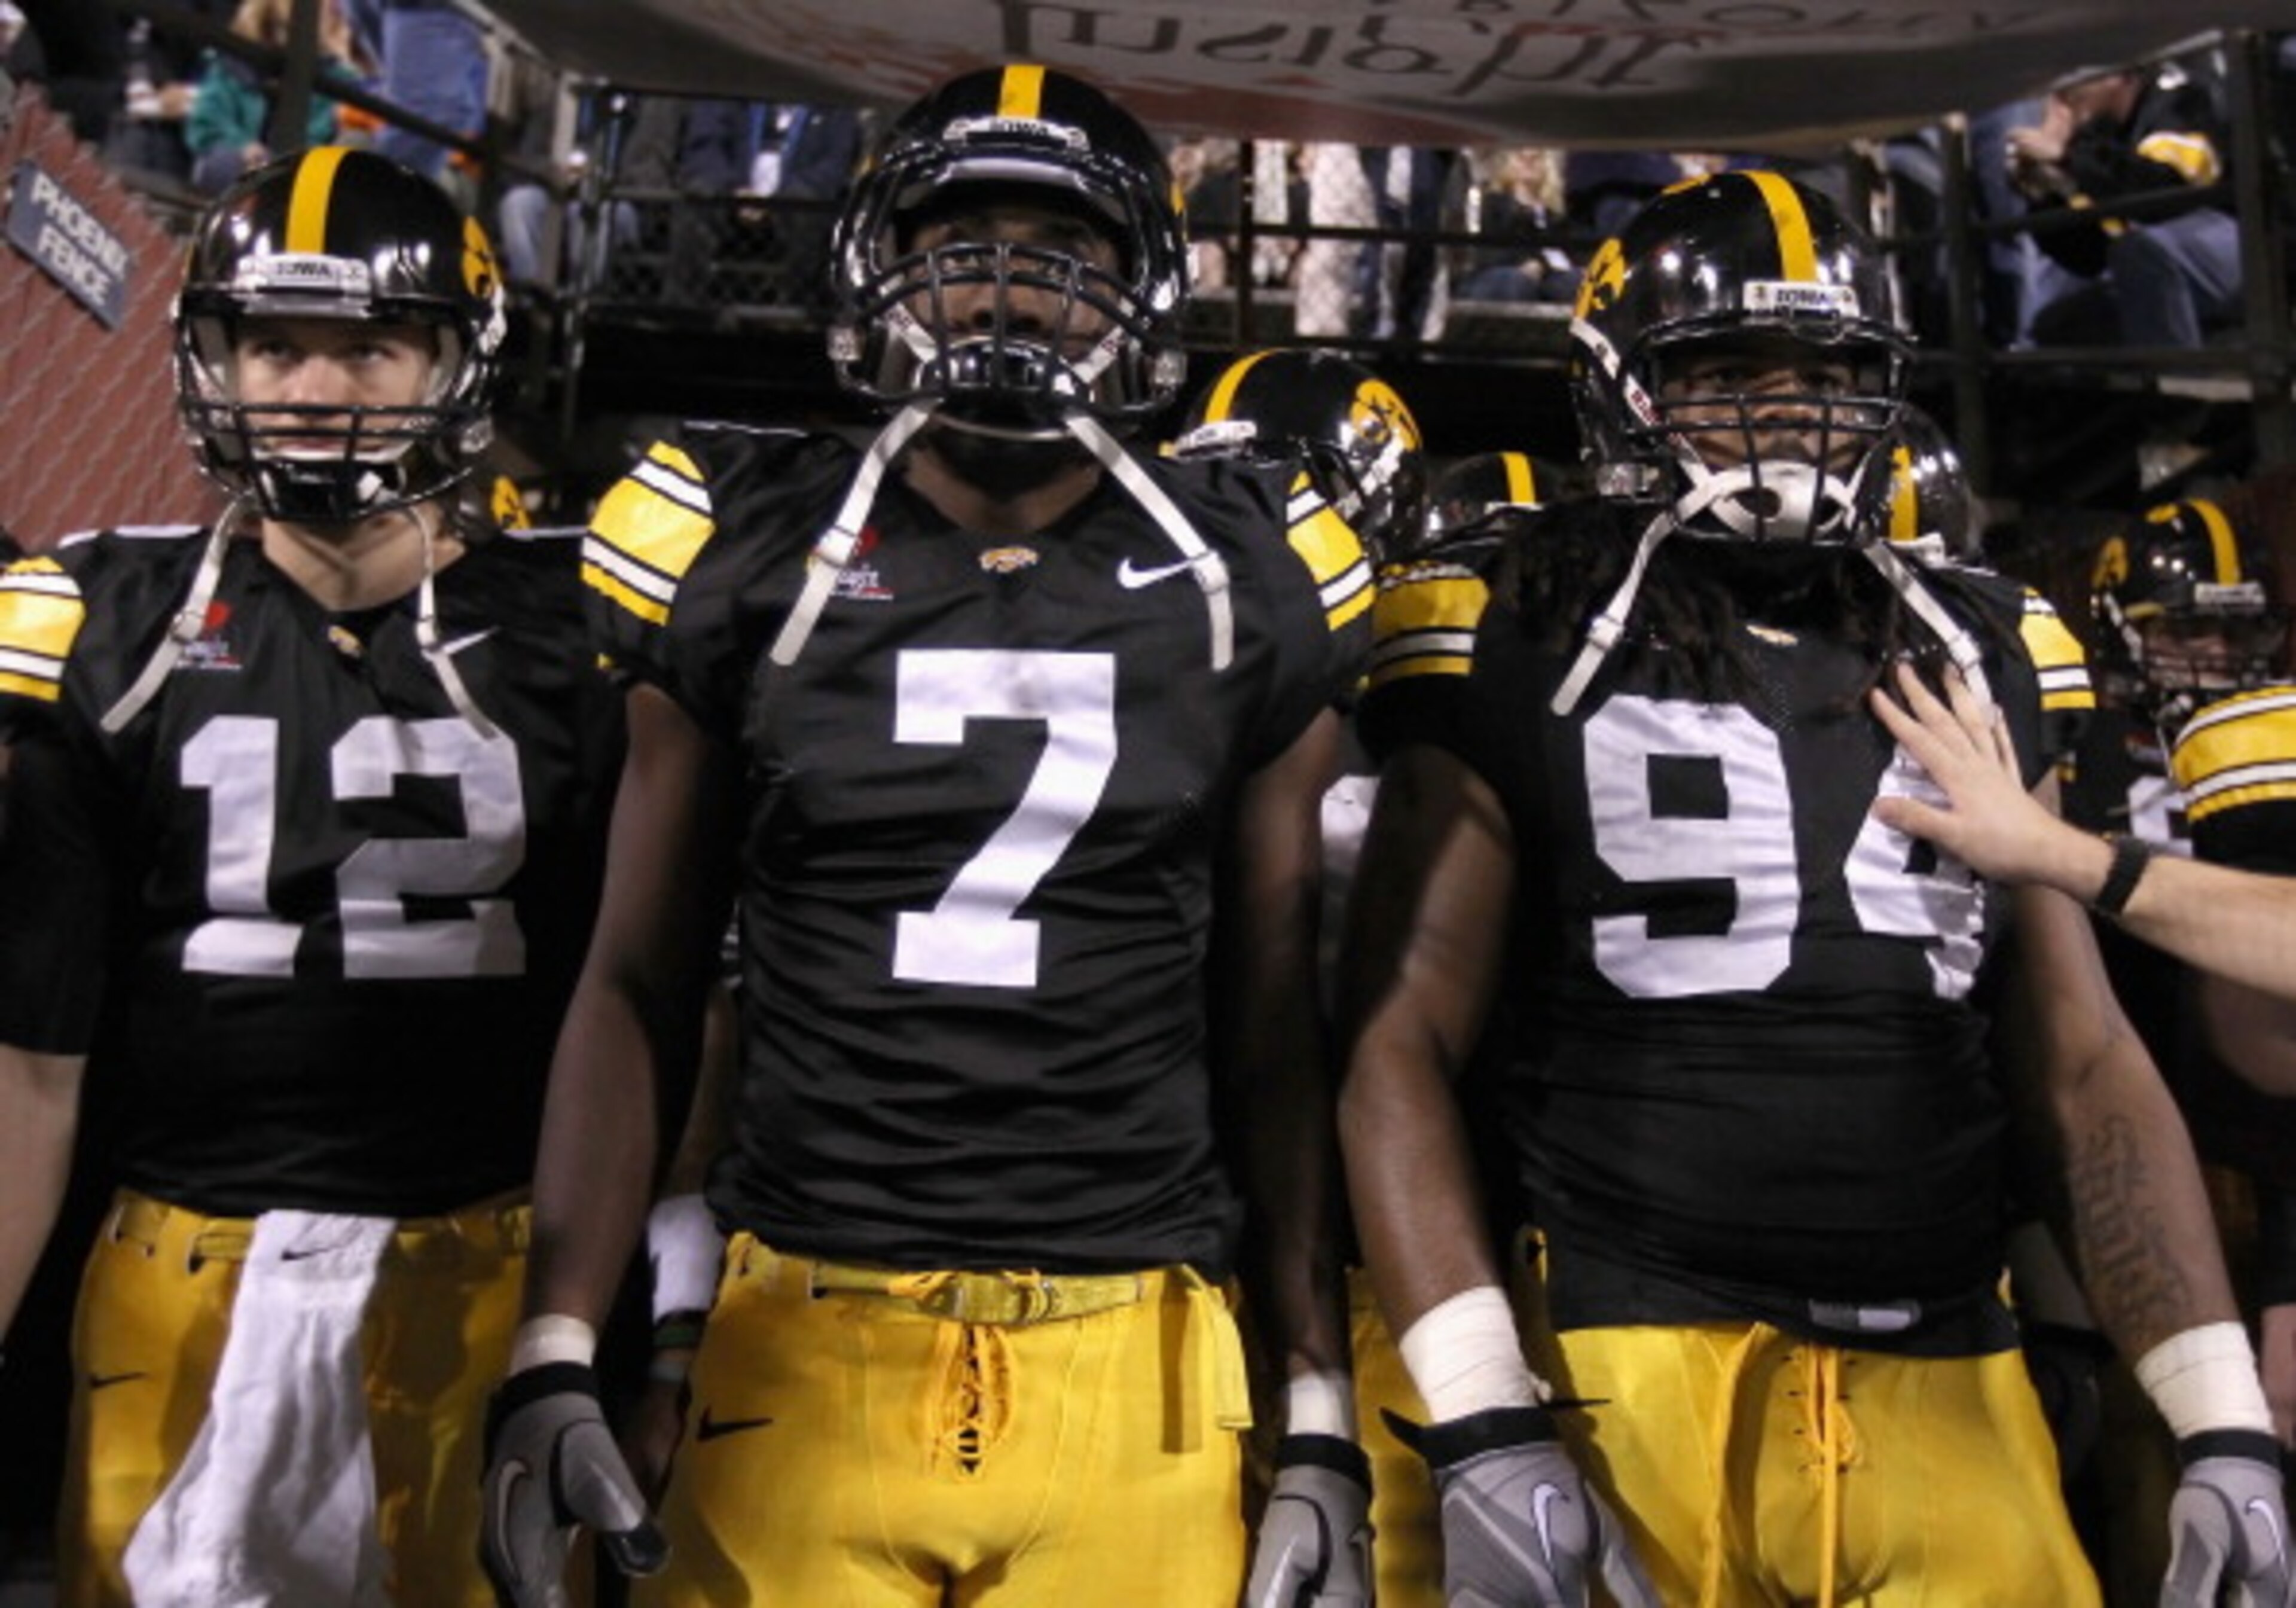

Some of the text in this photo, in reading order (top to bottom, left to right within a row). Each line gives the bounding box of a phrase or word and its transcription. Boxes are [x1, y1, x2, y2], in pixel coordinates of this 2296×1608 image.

[38, 224, 112, 306] FENCE
[181, 715, 527, 979] 12
[892, 649, 1118, 987] 7
